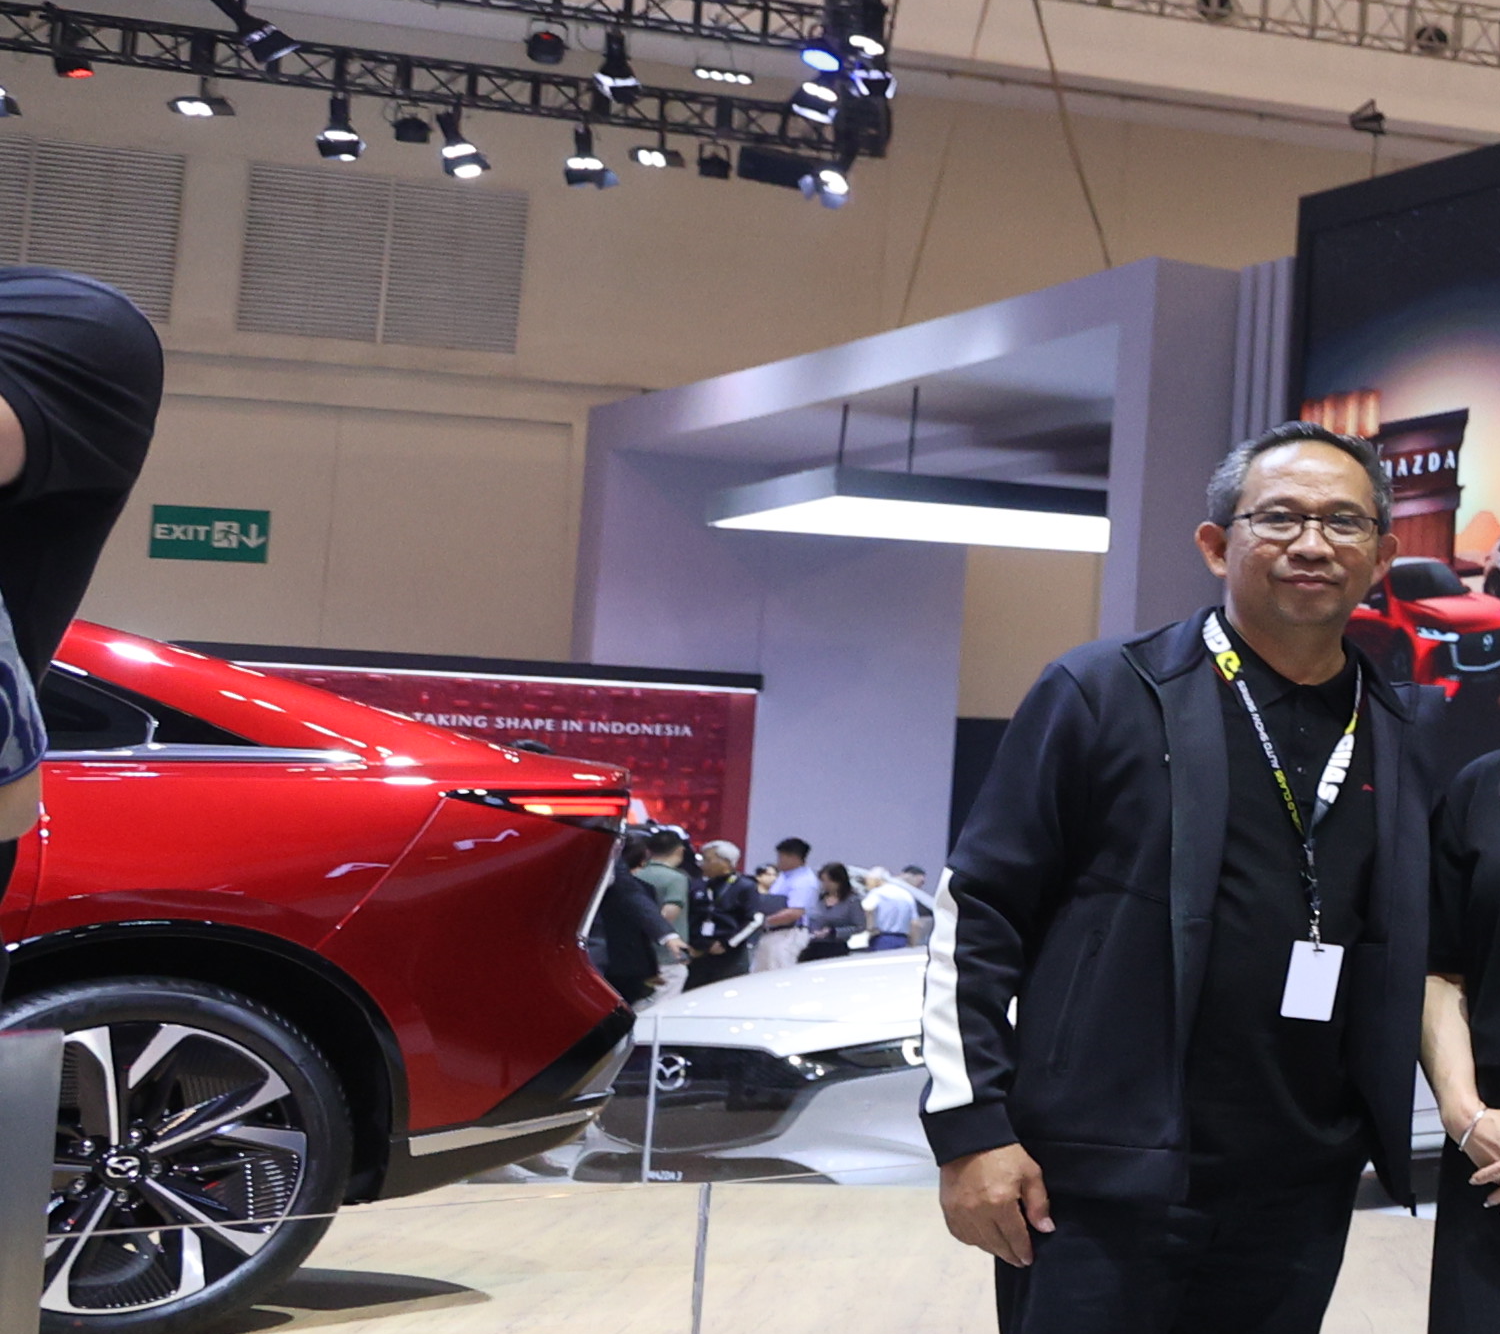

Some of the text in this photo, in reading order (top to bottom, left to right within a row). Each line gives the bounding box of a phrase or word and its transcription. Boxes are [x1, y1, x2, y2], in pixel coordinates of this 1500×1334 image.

[154, 523, 210, 541] EXIT
[412, 712, 693, 737] TAKING SHAPE IN INDONESIA
